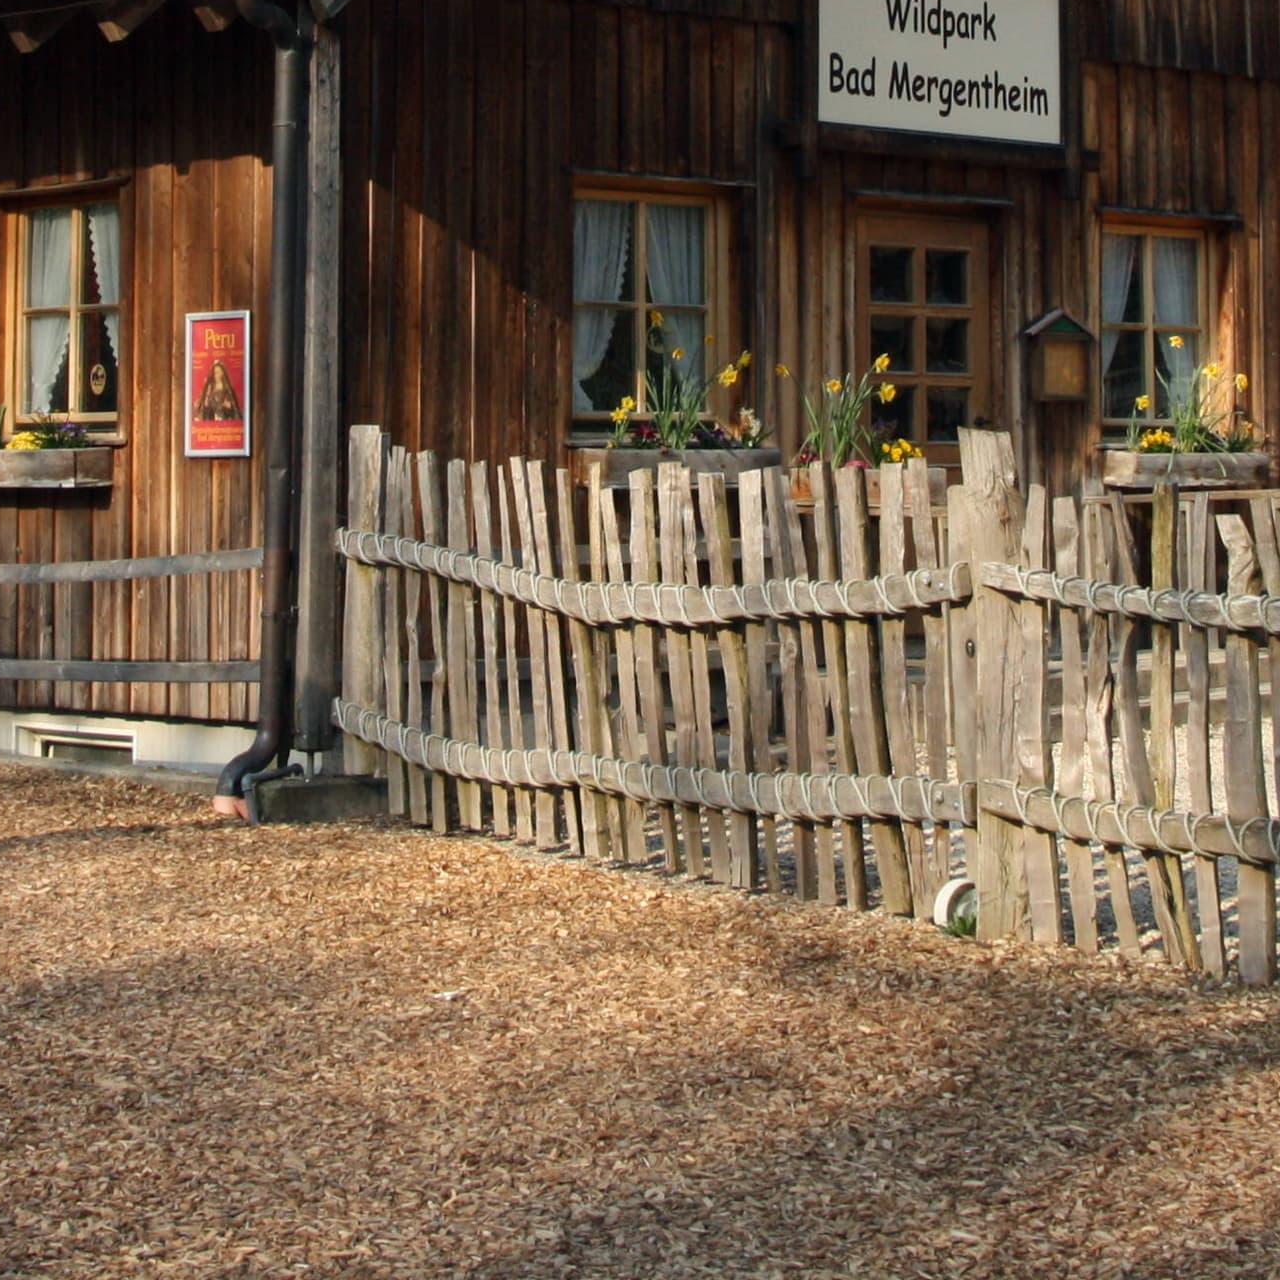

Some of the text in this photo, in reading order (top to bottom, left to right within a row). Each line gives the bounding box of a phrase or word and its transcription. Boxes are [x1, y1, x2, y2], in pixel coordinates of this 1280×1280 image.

[828, 52, 1049, 117] Bad Mergentheim
[204, 328, 235, 349] Peru
